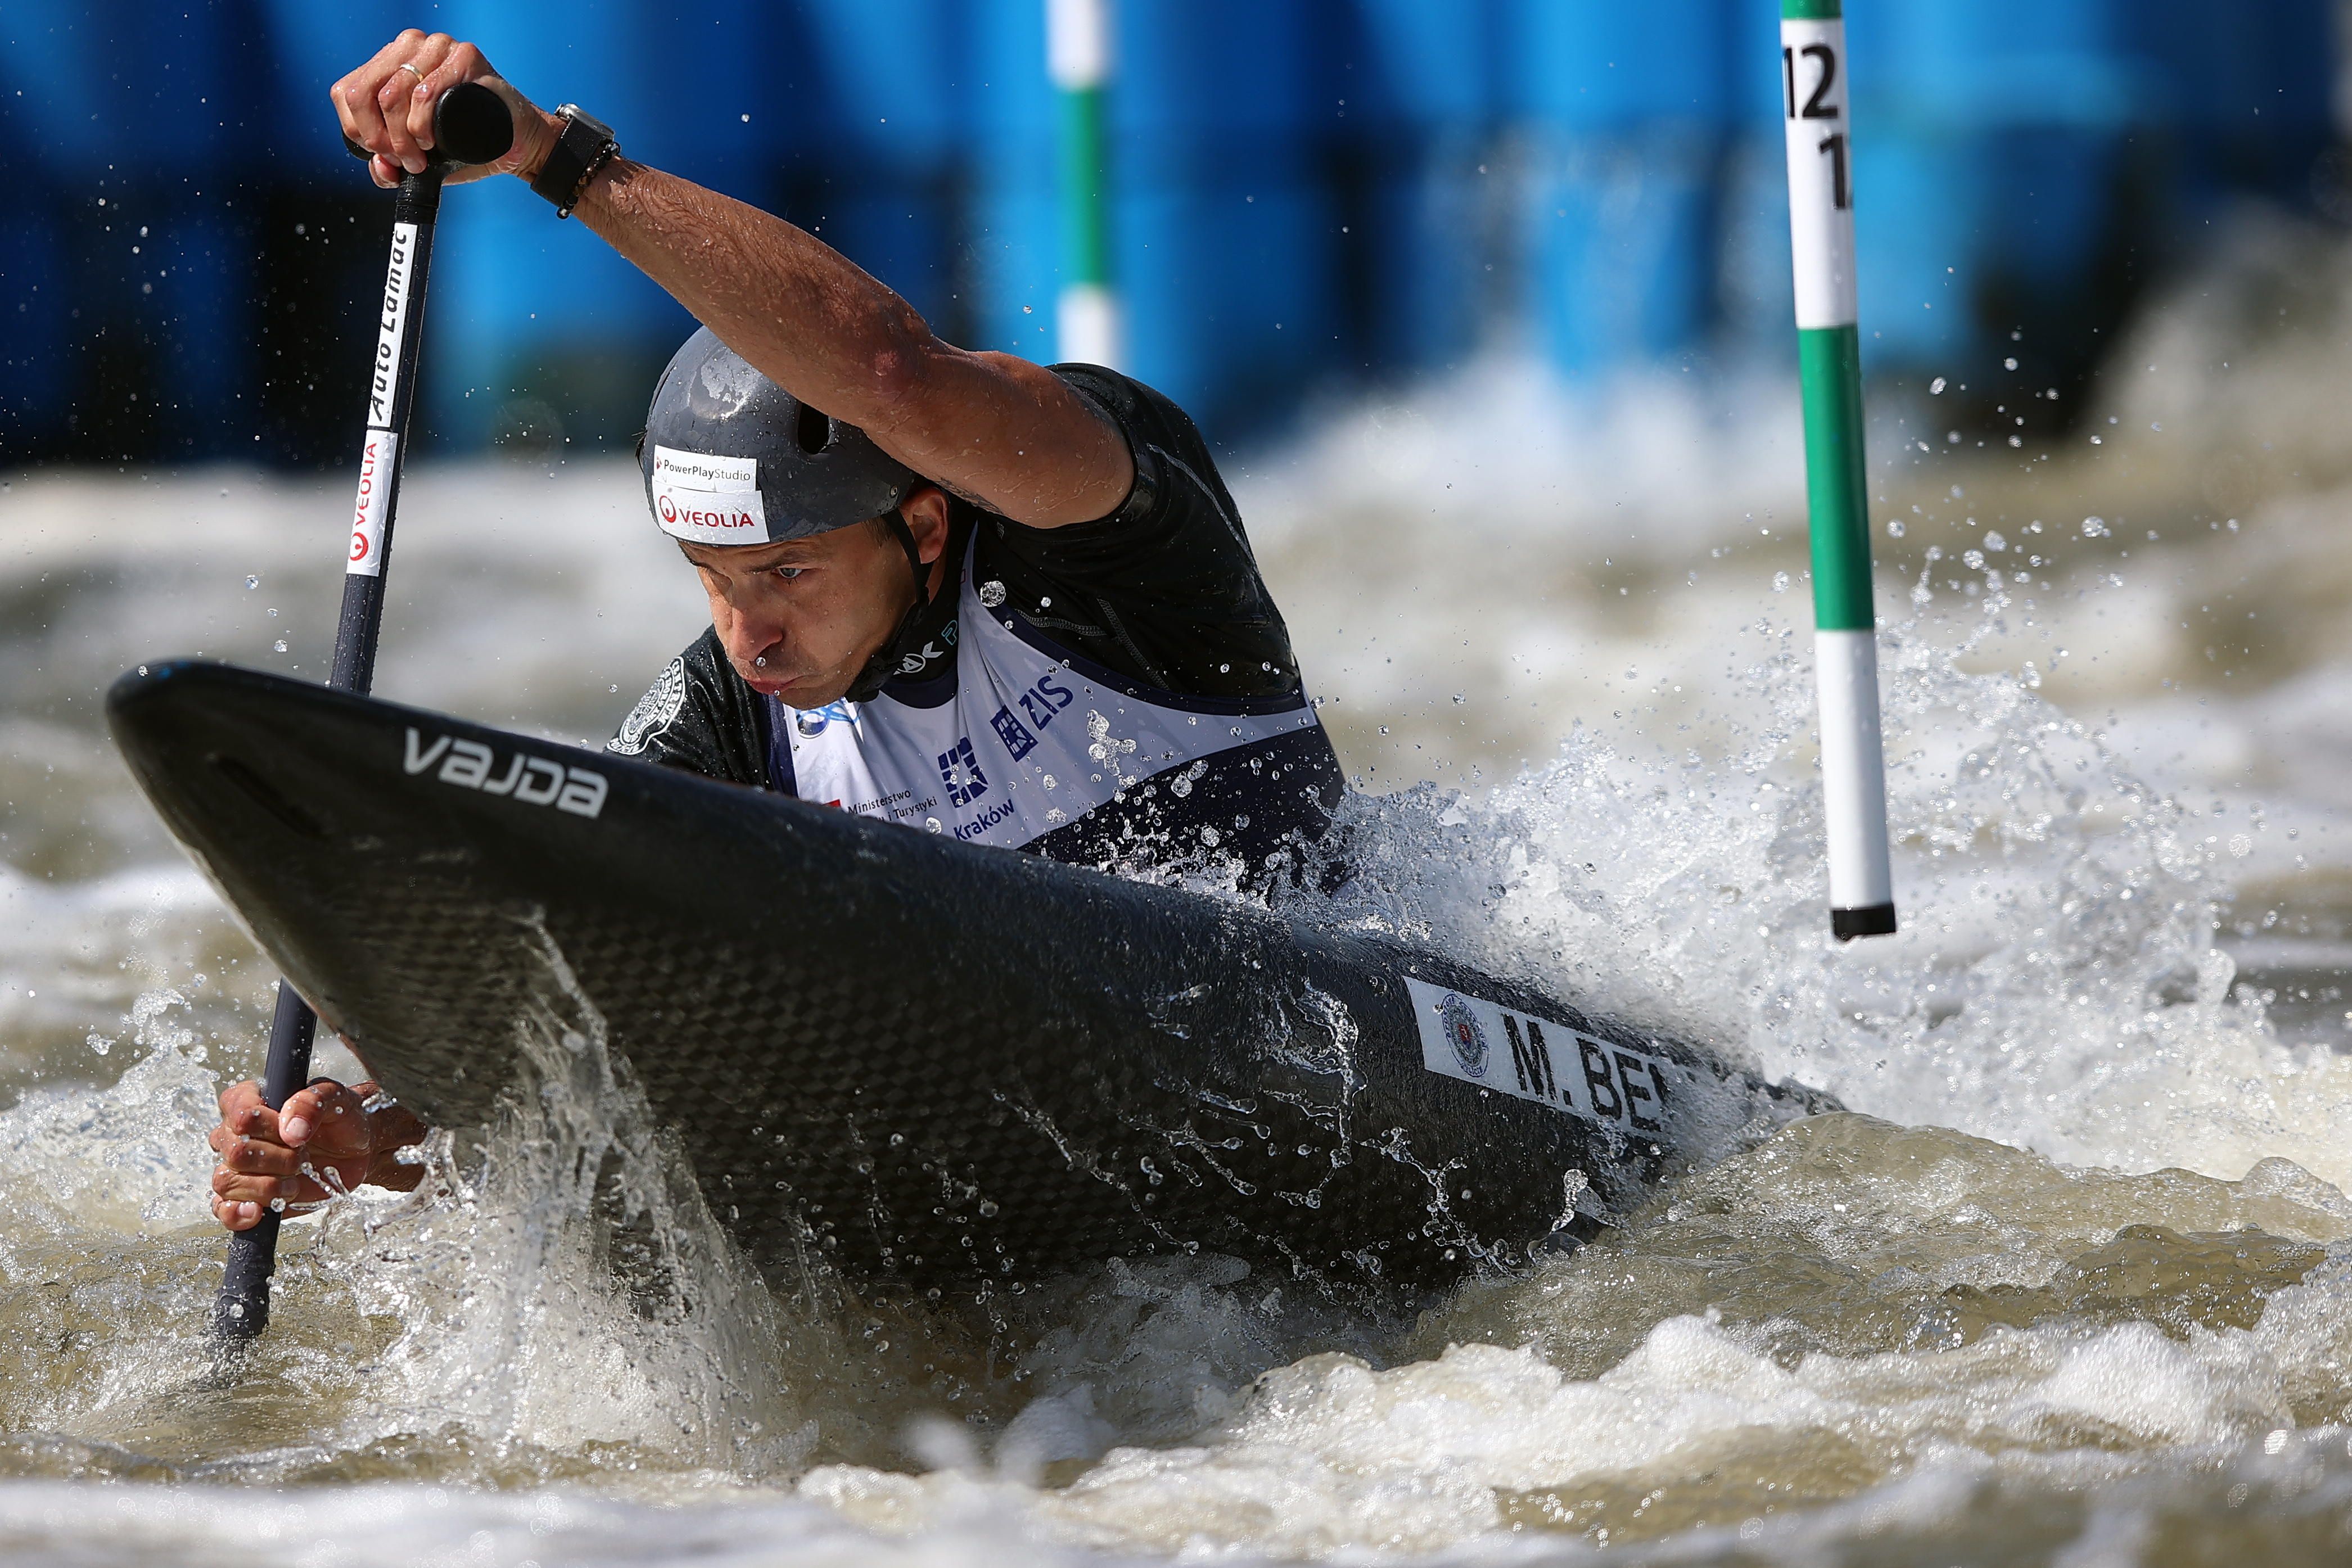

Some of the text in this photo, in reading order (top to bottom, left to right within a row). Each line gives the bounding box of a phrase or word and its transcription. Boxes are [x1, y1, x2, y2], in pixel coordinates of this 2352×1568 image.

[1784, 44, 1838, 119] 12
[1819, 134, 1849, 209] 1
[371, 342, 391, 422] Auto
[355, 442, 377, 526] VEOLIA
[664, 459, 751, 481] PowerPlayStudio
[679, 507, 755, 527] VEOLIA
[1018, 675, 1073, 730] ZIS
[848, 790, 911, 814] Ministerstwo
[893, 796, 938, 819] Turystyki
[954, 799, 1015, 841] Kraków
